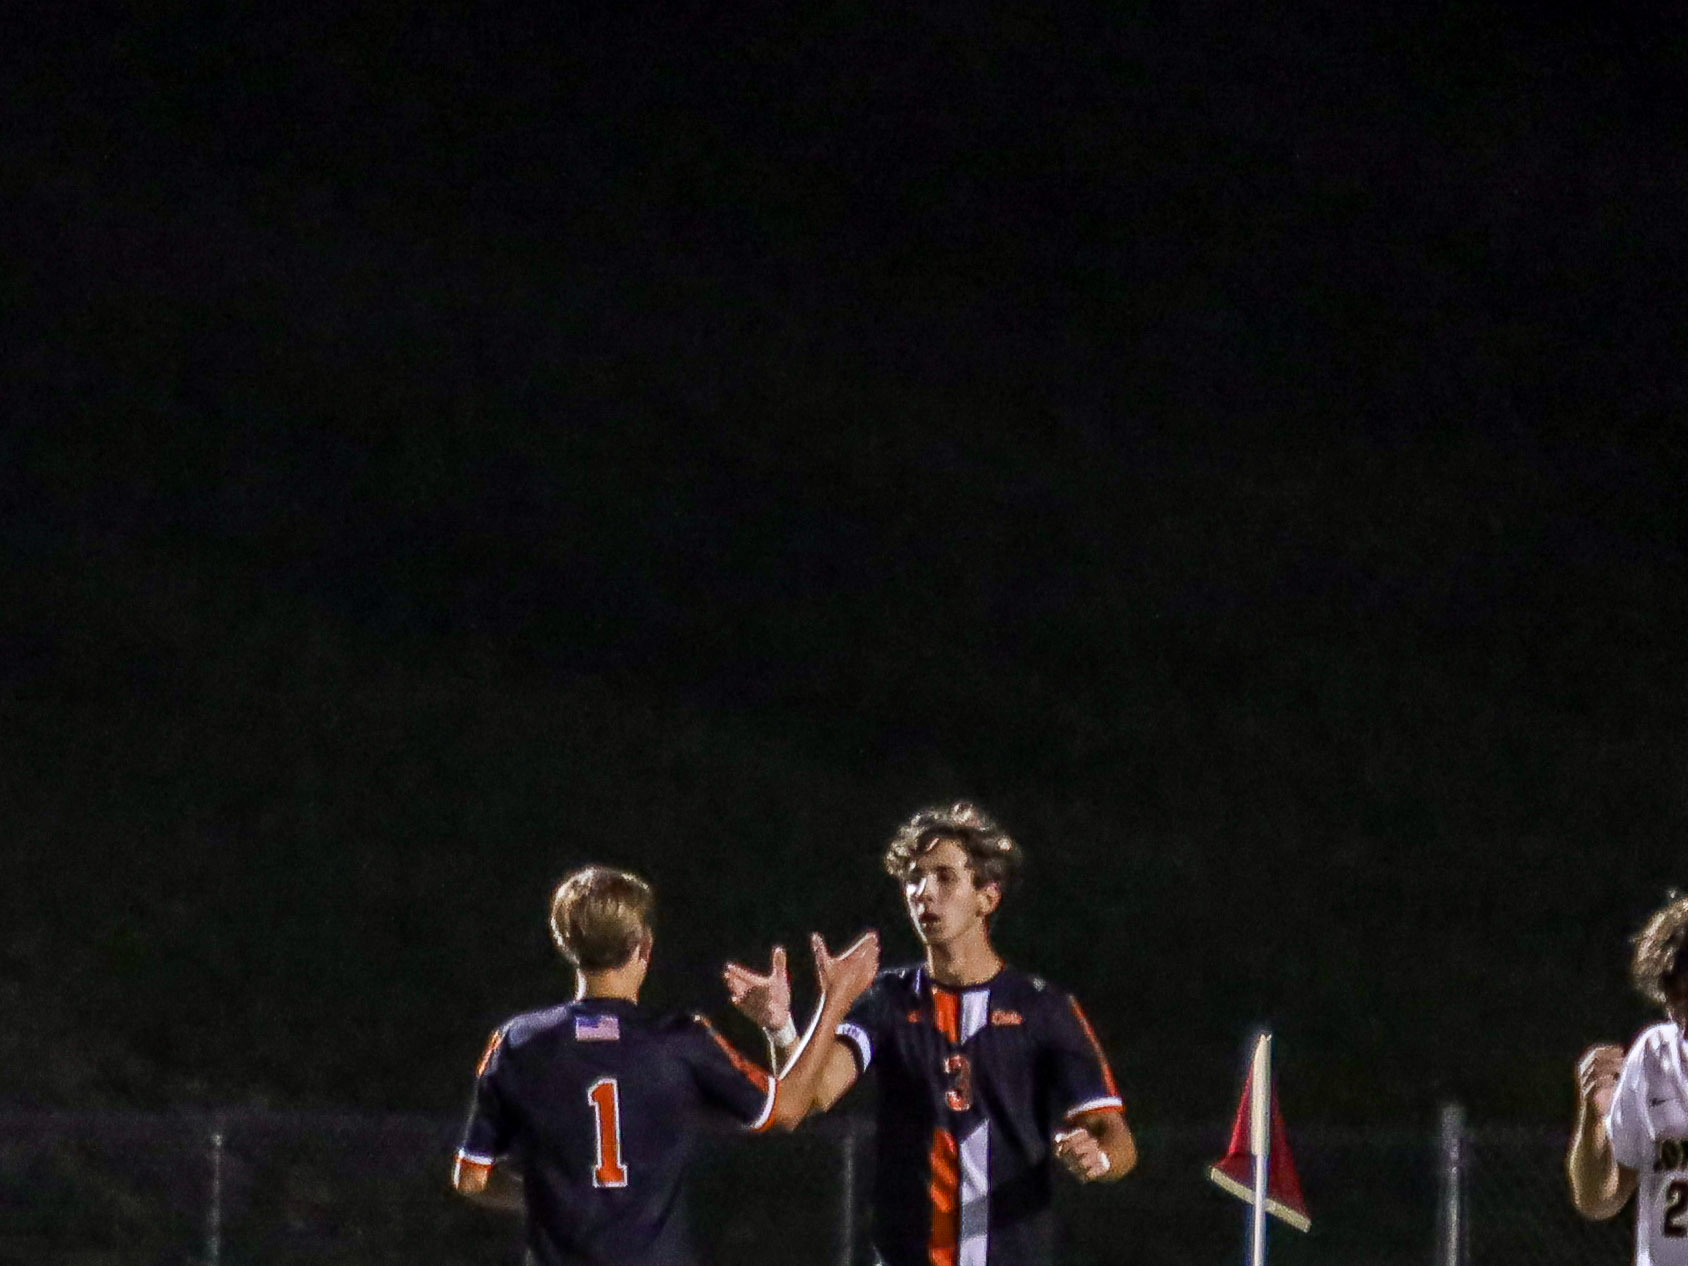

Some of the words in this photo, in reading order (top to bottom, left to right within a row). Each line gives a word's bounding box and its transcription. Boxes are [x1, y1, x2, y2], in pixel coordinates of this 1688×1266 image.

[944, 1054, 973, 1112] 3
[587, 1078, 628, 1188] 1
[1664, 1178, 1688, 1238] 2
